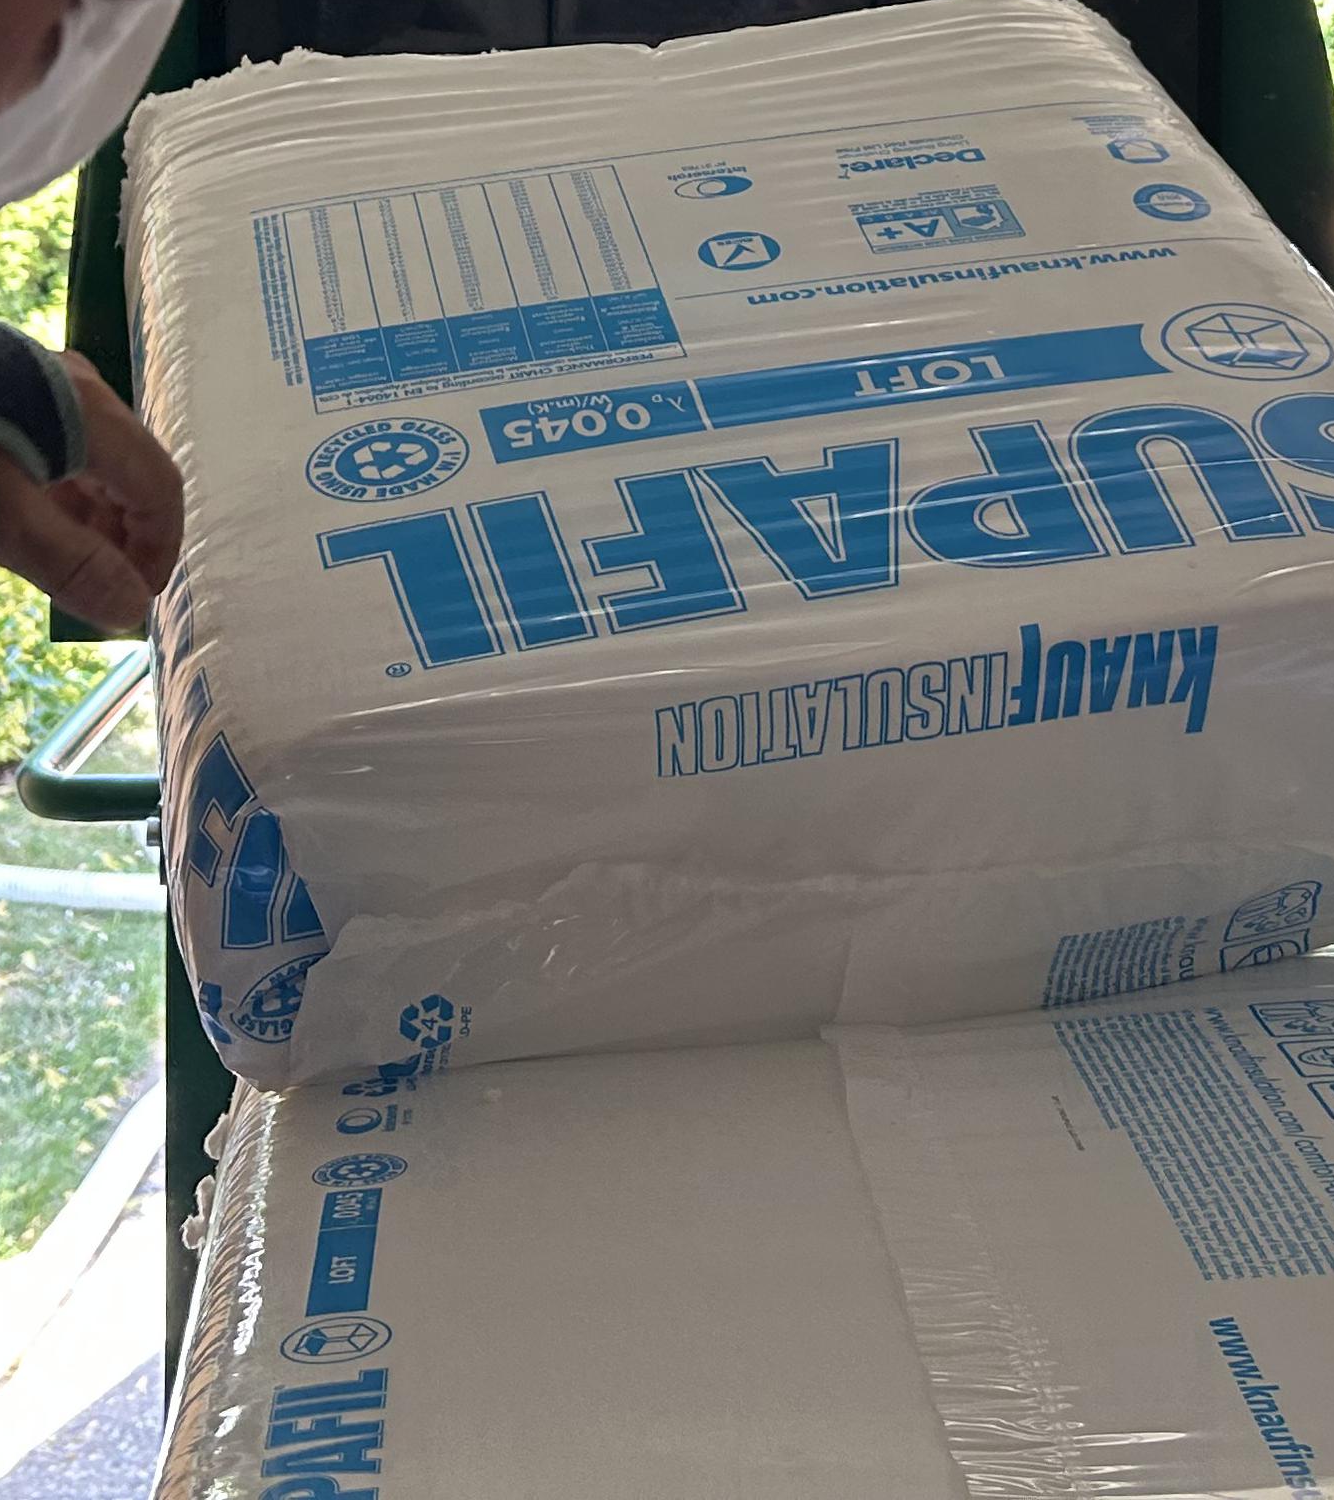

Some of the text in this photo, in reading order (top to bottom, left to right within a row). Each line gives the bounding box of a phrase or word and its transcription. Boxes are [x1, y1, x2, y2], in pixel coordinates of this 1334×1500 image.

[876, 218, 940, 241] A+
[746, 246, 1177, 309] www.knaufinsulation.com
[508, 366, 552, 380] CHART
[554, 353, 654, 372] PERFORMANCE
[849, 352, 1007, 402] LOFT
[404, 388, 423, 397] EN
[400, 420, 457, 445] GLASS
[313, 422, 392, 470] RECYCLED
[314, 471, 367, 499] USING
[375, 472, 438, 498] MADE
[237, 1011, 294, 1034] GLASS
[327, 1254, 358, 1284] LOFT
